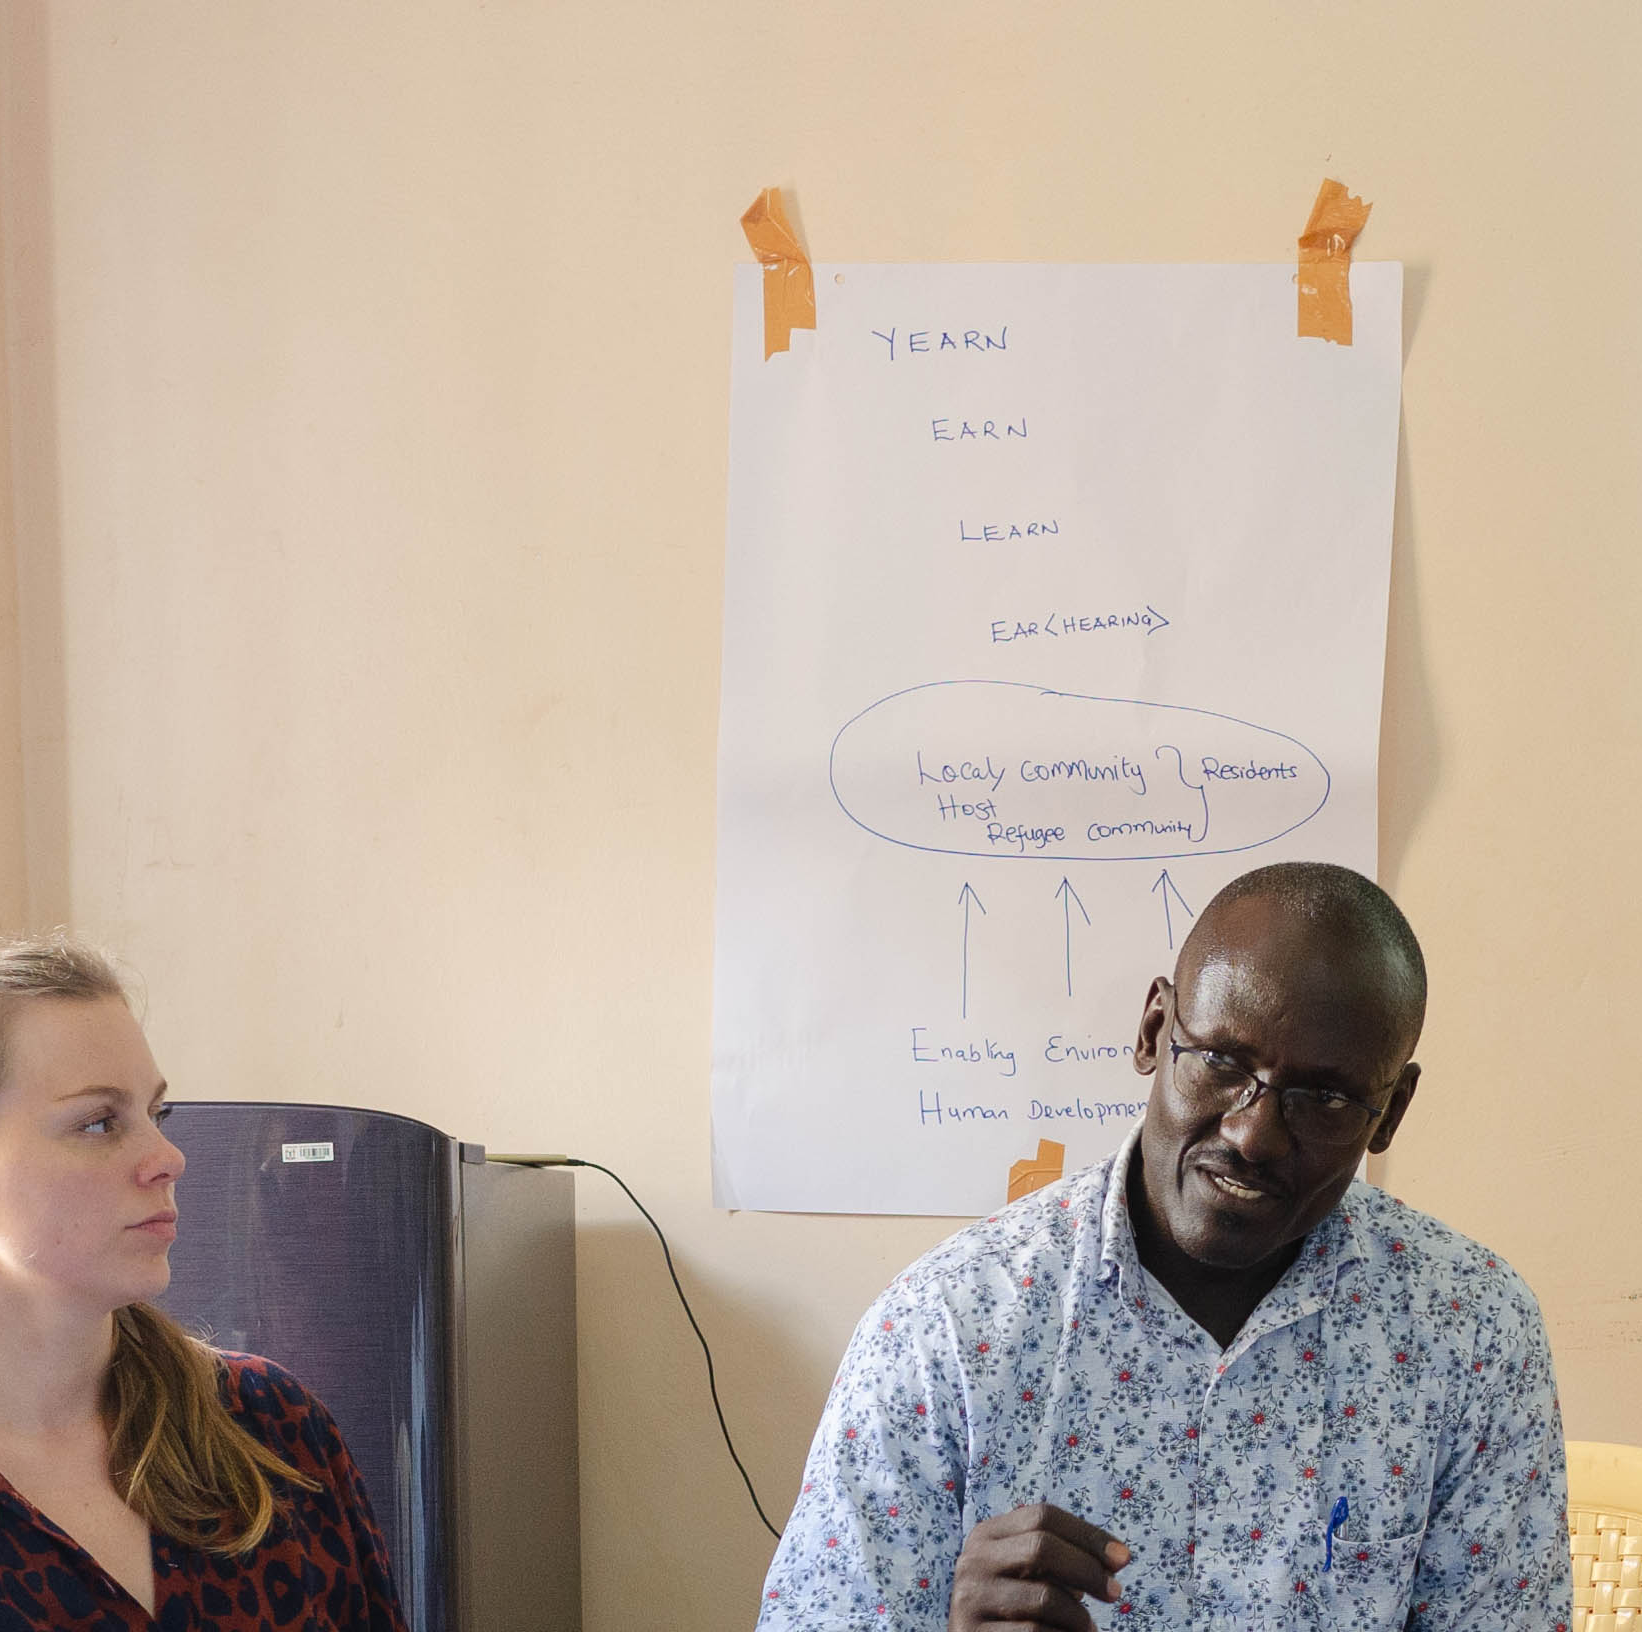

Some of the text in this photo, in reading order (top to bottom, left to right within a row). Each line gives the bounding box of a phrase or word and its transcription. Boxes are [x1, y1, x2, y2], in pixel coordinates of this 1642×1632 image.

[872, 326, 1008, 361] YEARN
[932, 417, 1028, 440] EARN
[960, 520, 1059, 541] LEARN
[1202, 757, 1298, 781] Residents
[937, 794, 997, 821] Host
[986, 822, 1066, 853] Refugee
[912, 1027, 1135, 1077] Enabling Environ
[919, 1089, 1149, 1126] Human Developmen
